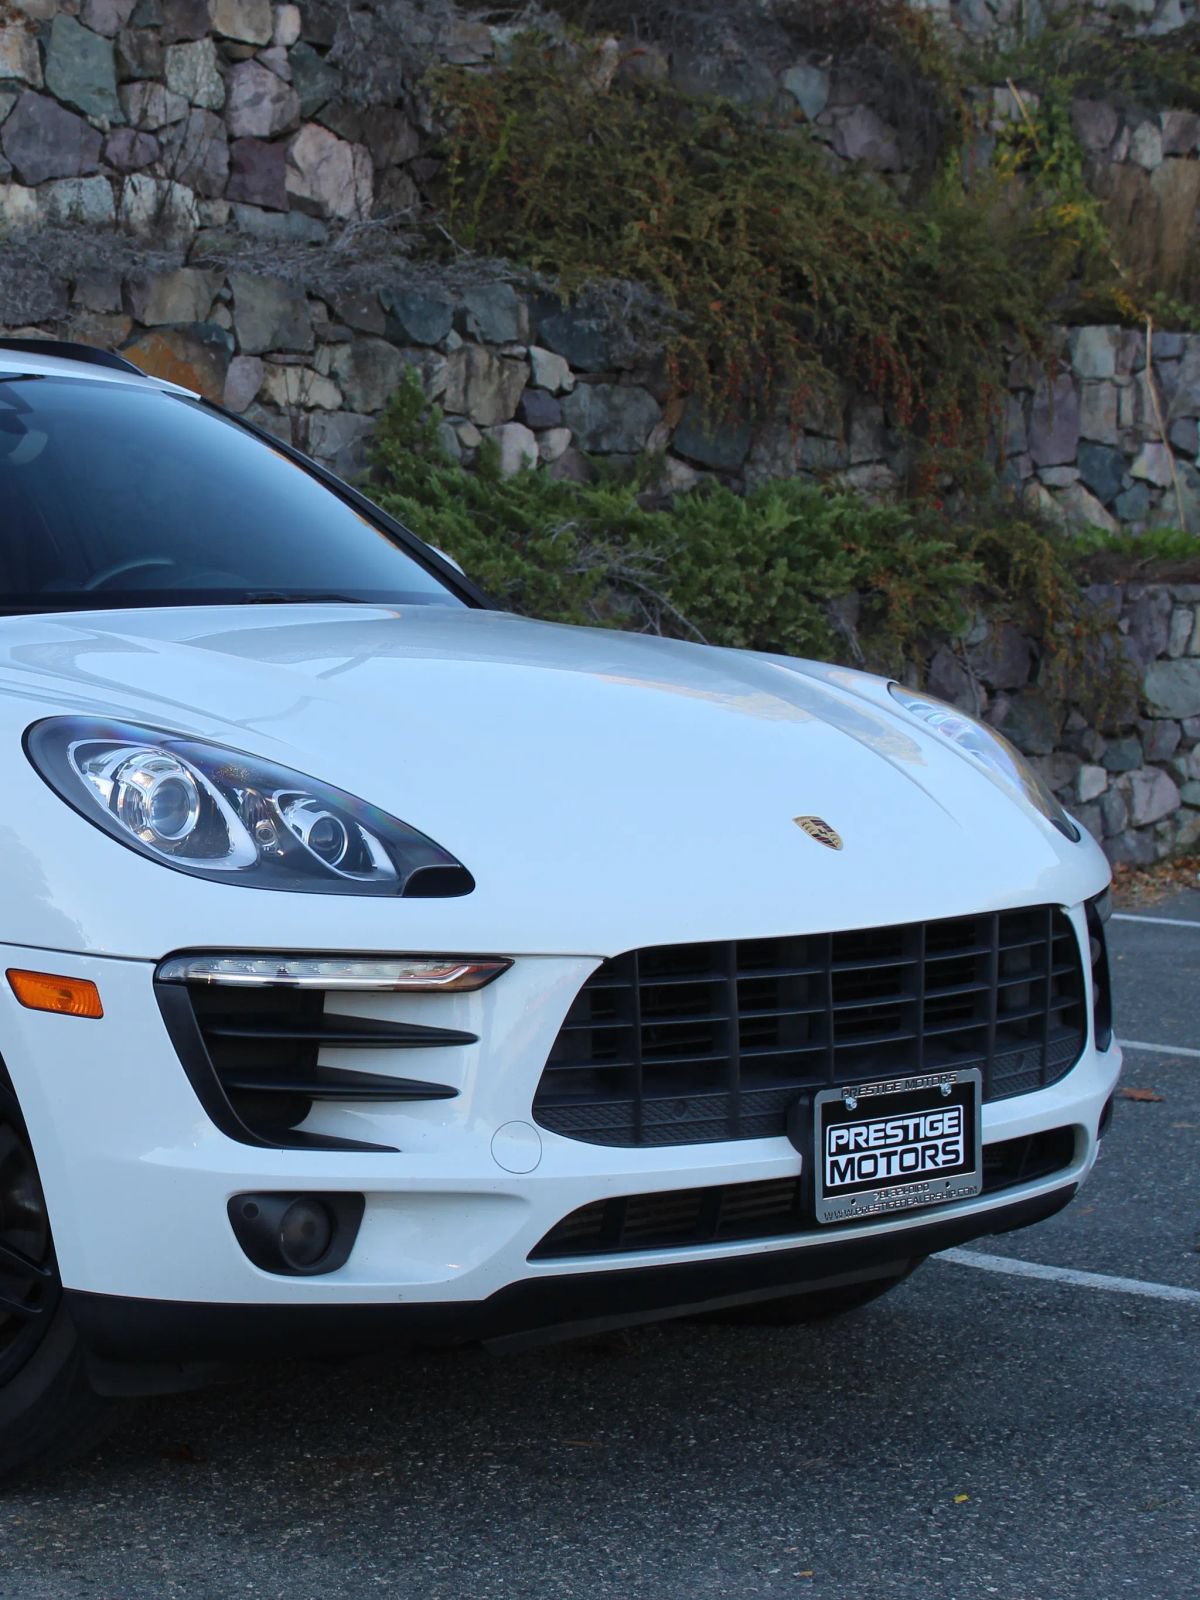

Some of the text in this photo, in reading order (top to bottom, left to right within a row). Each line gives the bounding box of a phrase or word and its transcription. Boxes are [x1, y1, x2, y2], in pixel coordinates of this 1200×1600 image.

[841, 1073, 958, 1098] PRESTIGE MOTORS
[830, 1111, 960, 1154] PRESTIGE
[829, 1139, 960, 1185] MOTORS
